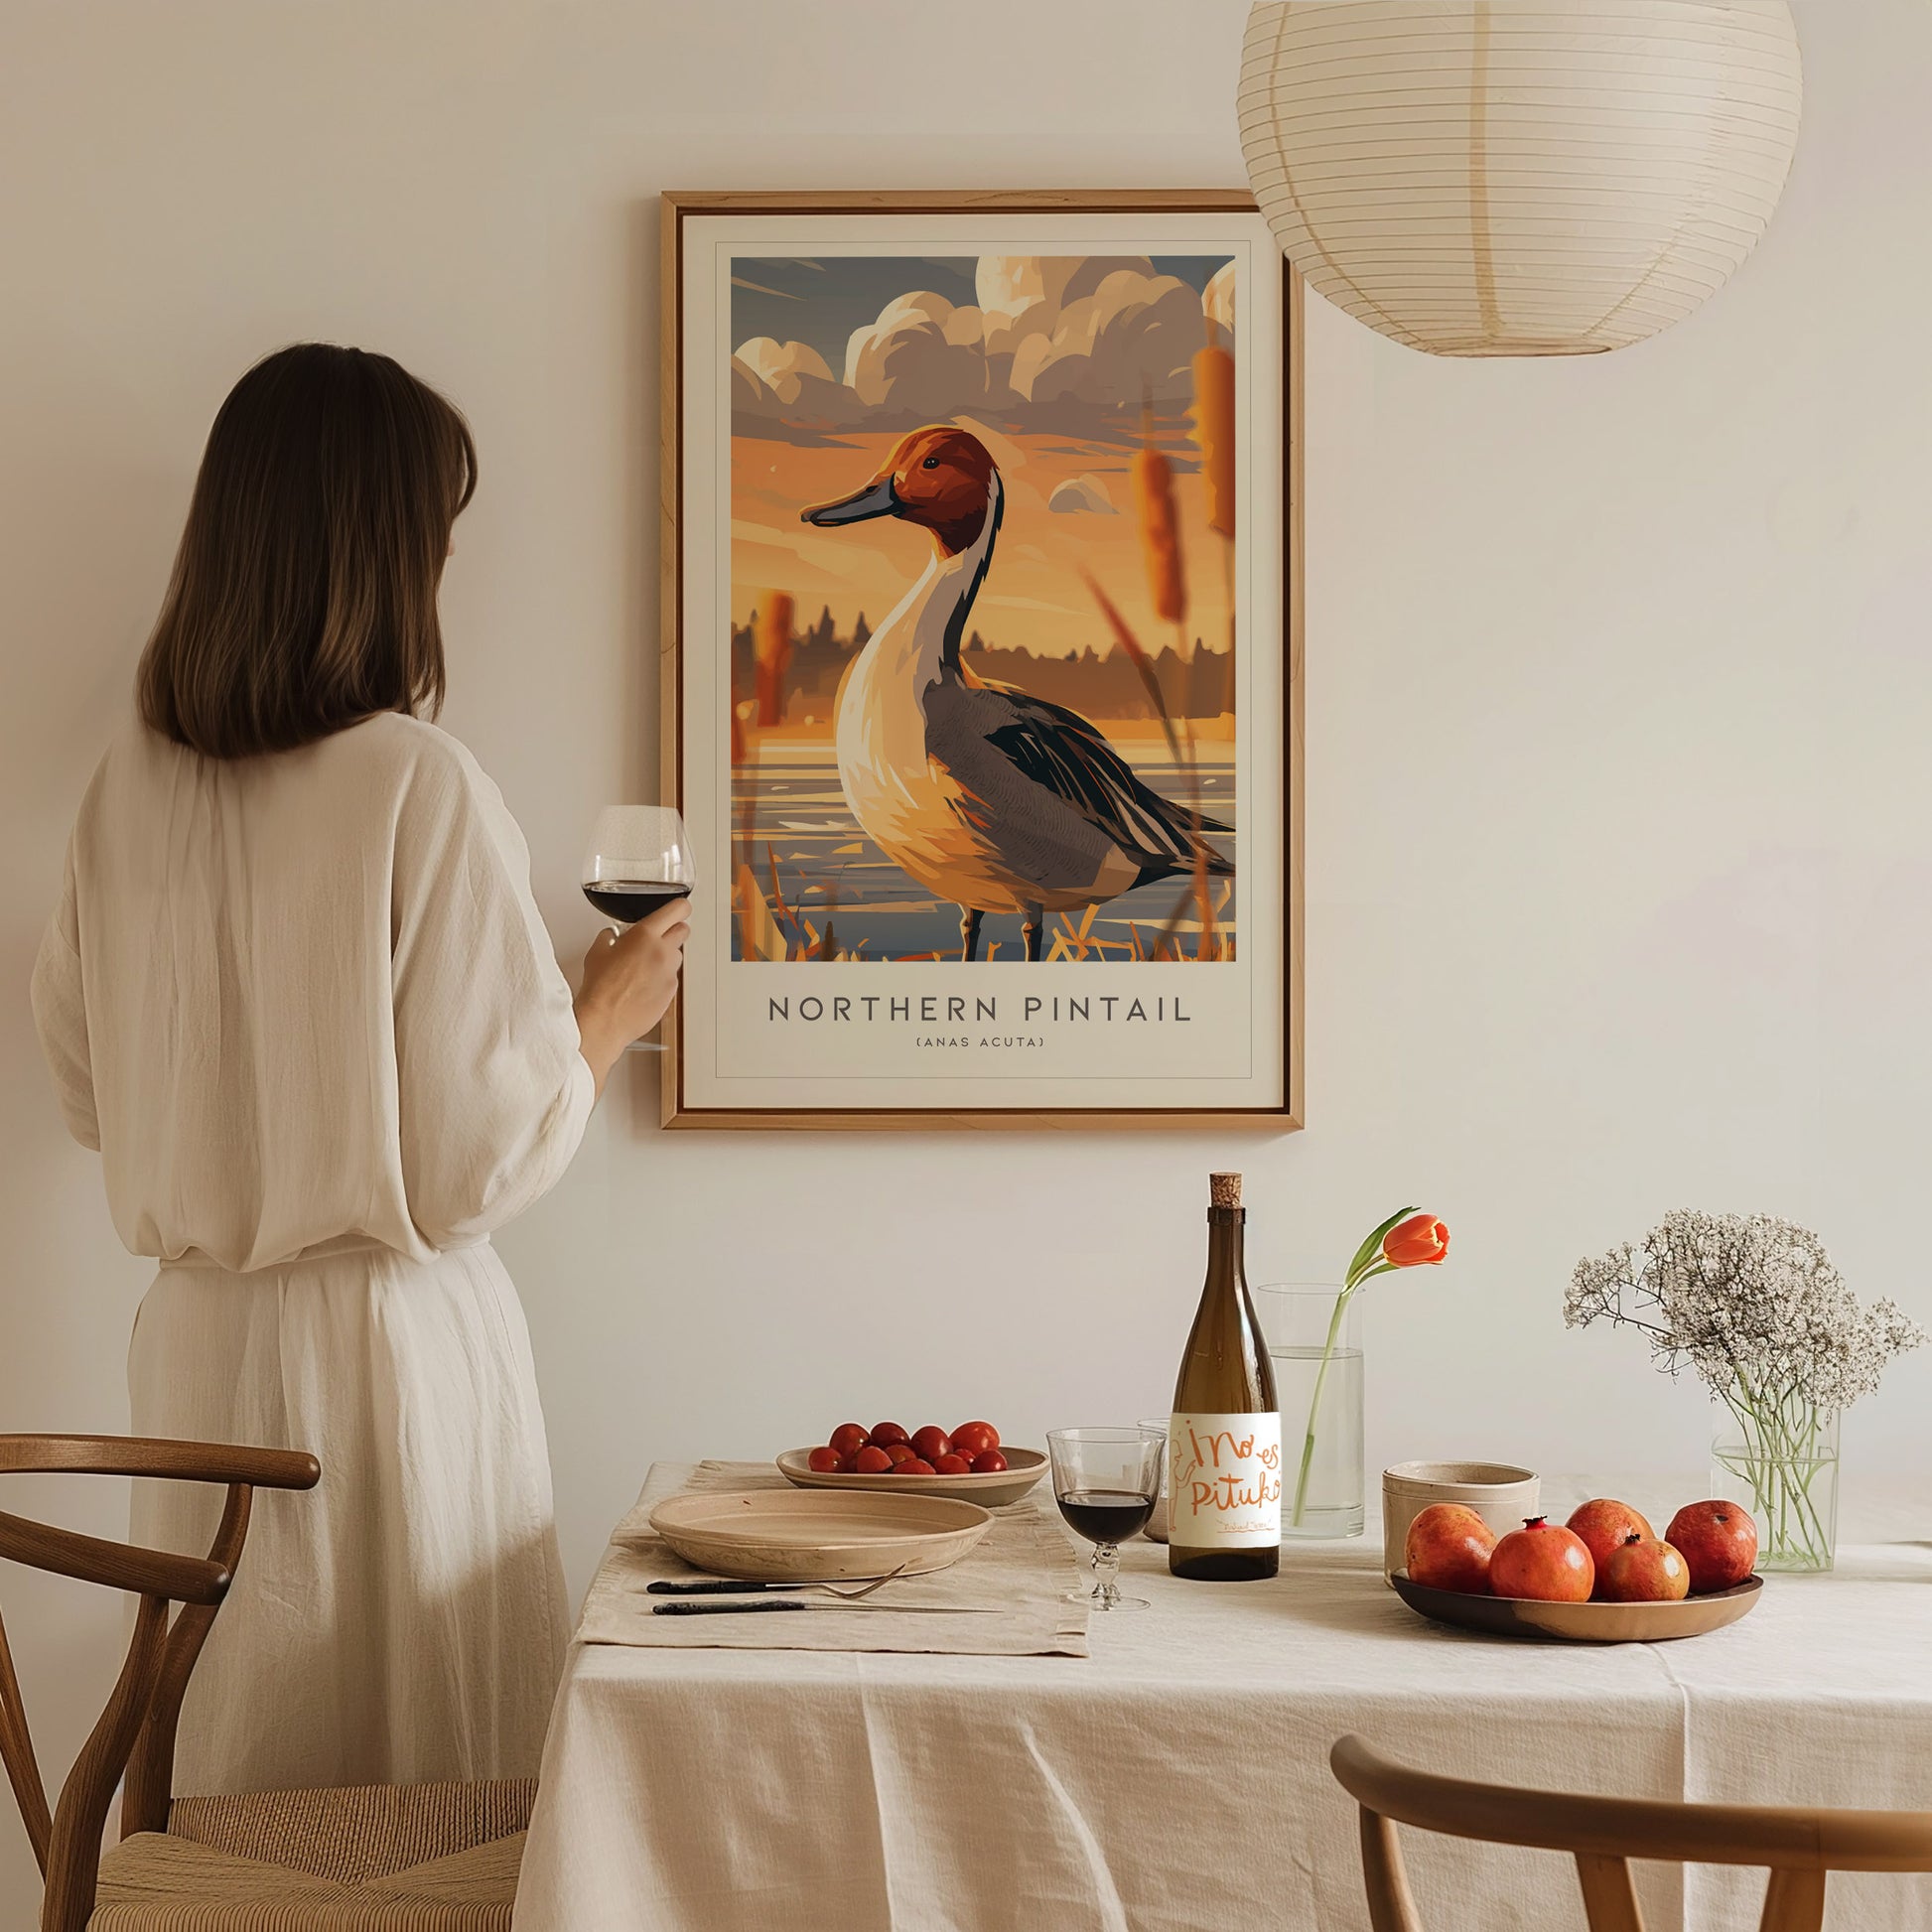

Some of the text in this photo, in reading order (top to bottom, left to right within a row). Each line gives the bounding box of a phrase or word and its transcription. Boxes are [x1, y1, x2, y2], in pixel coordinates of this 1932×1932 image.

[768, 996, 1191, 1022] NORTHERN PINTAIL
[915, 1036, 1044, 1047] (ANAS ACUTA)
[1256, 1444, 1279, 1469] es
